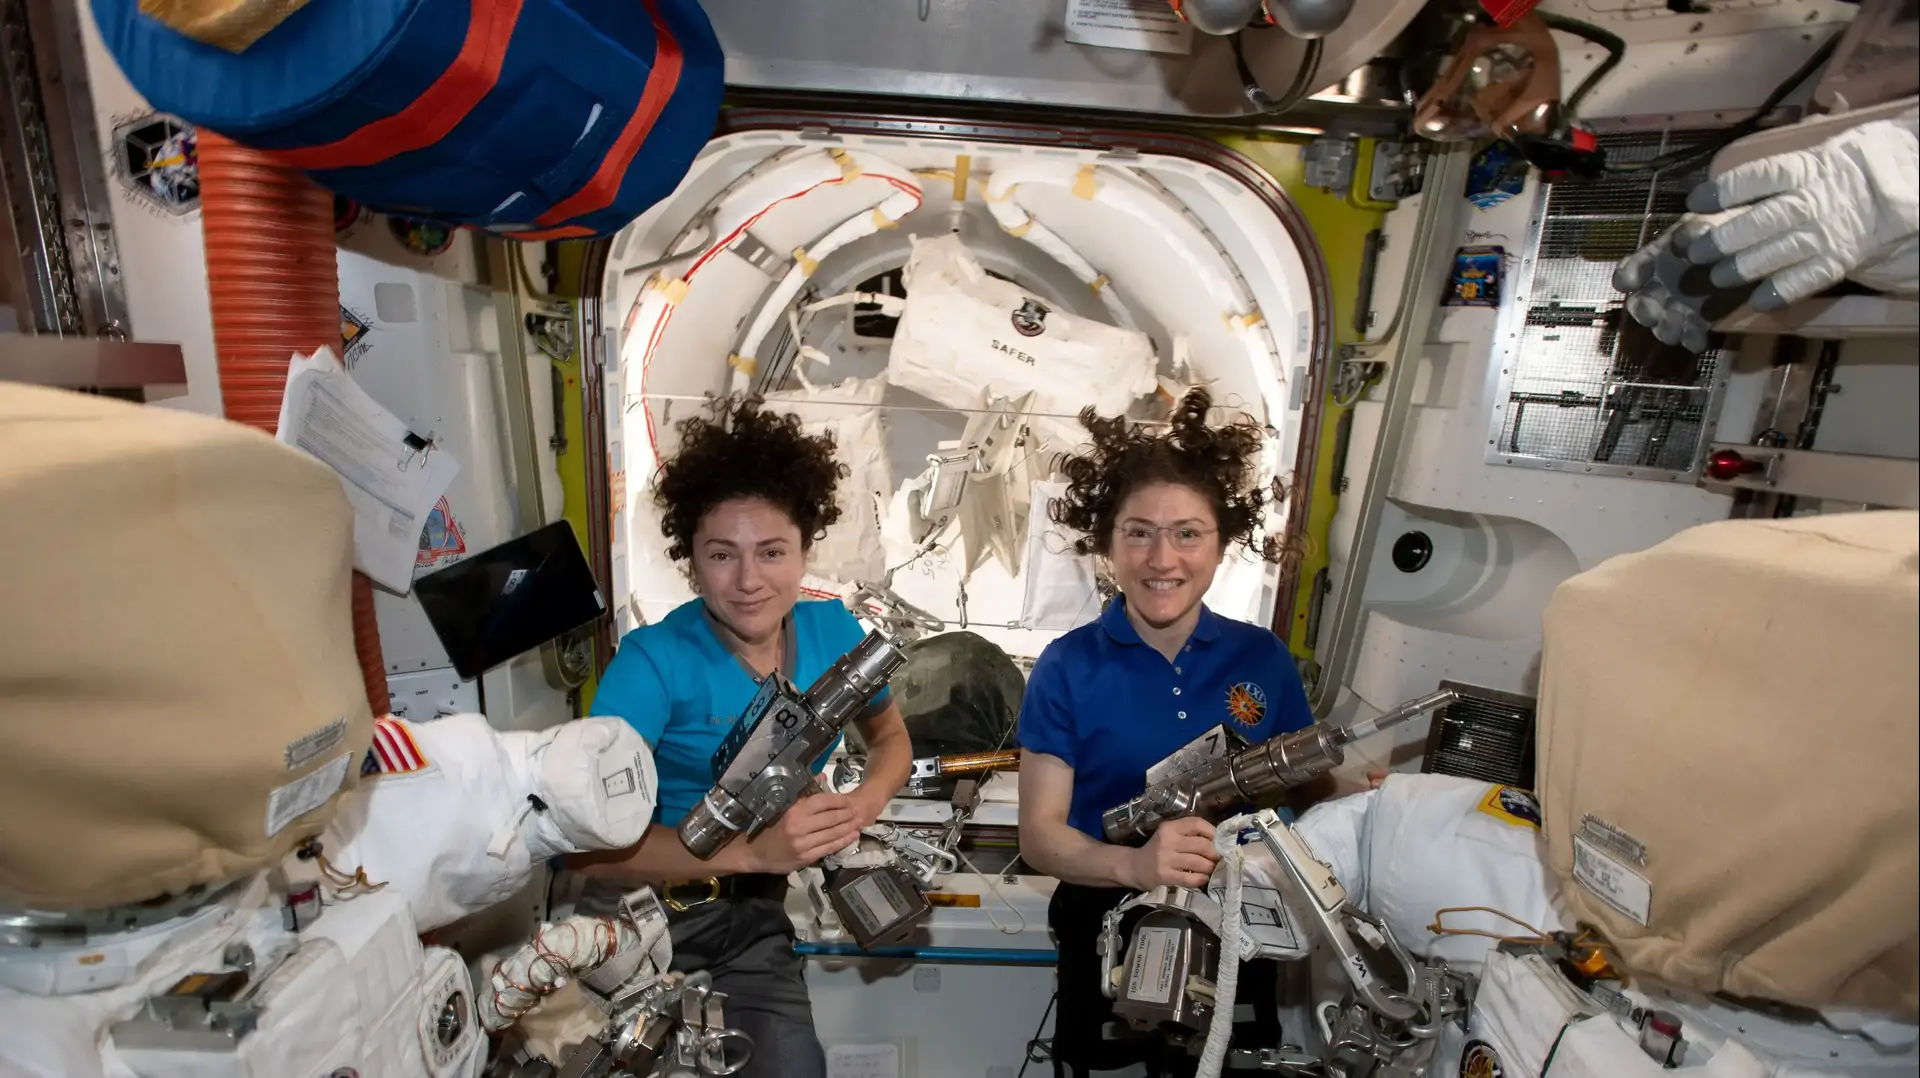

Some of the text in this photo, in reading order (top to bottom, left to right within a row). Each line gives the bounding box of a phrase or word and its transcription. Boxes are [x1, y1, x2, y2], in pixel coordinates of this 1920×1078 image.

[991, 339, 1036, 366] SAFER
[751, 697, 765, 716] 8
[776, 709, 798, 729] 8
[1205, 733, 1219, 754] 7
